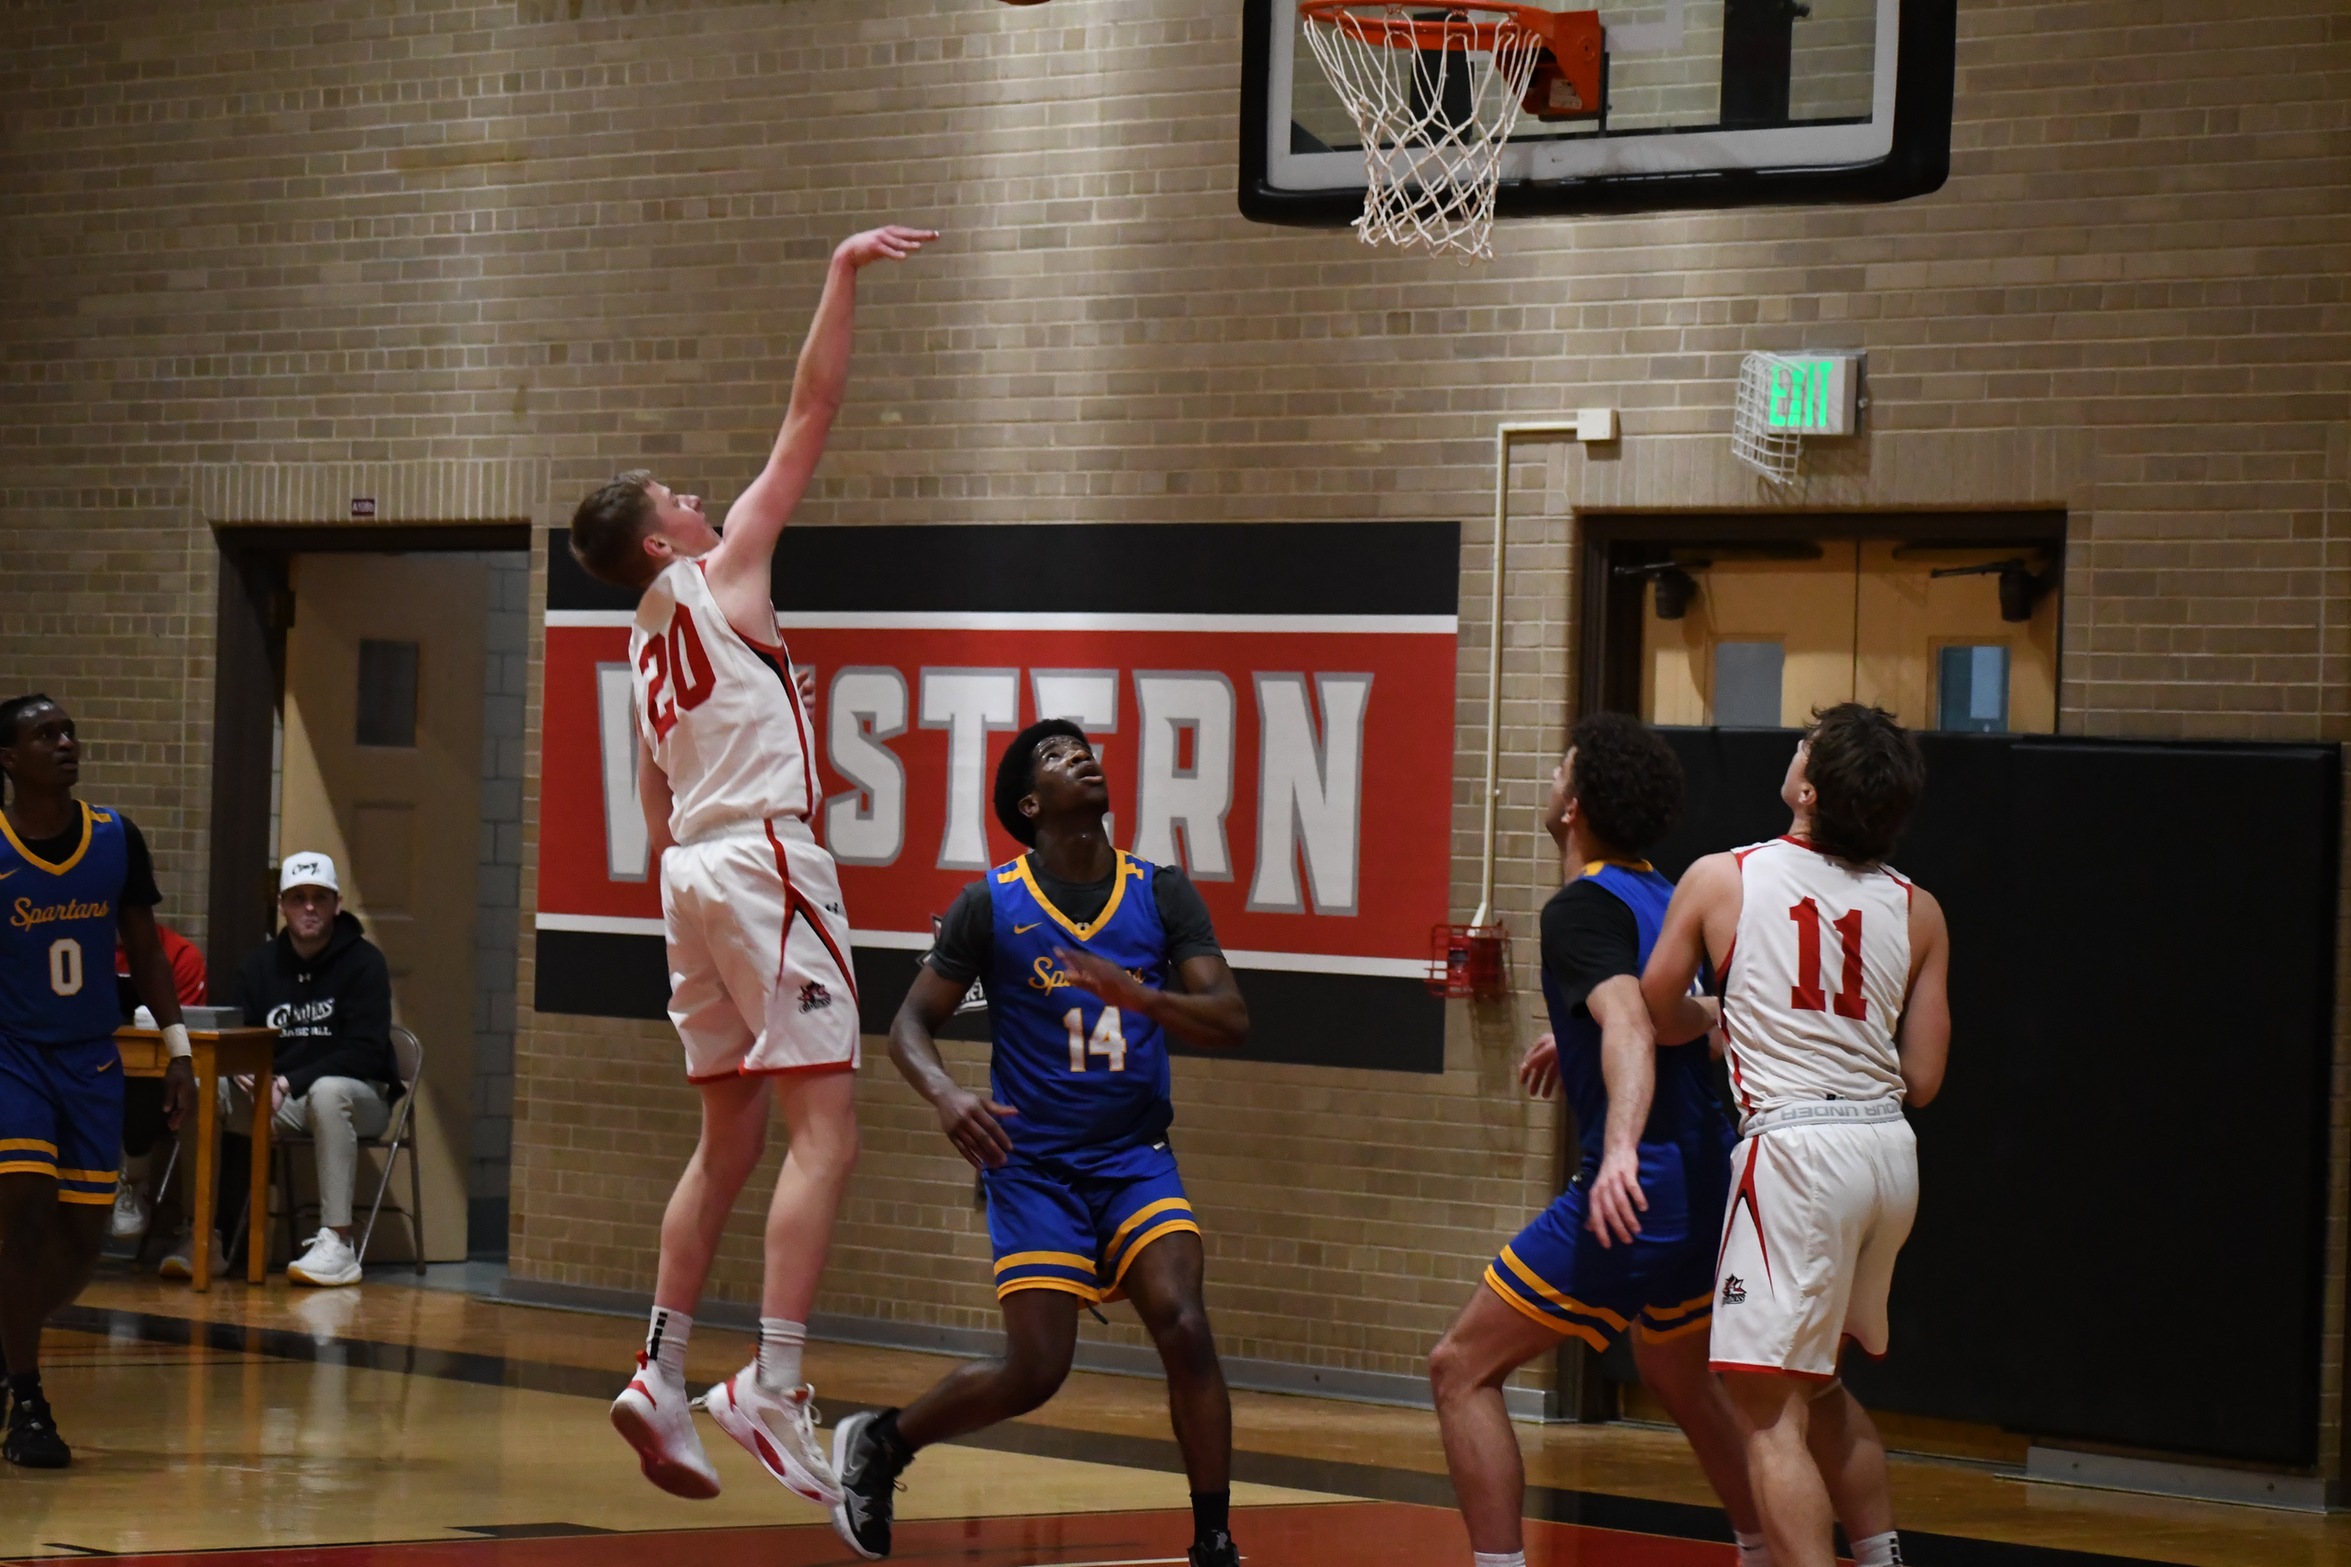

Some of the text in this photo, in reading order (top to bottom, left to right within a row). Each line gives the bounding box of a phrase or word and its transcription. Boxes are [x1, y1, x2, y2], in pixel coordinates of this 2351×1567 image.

[1768, 361, 1833, 427] EXIT
[639, 602, 716, 734] 20
[10, 897, 110, 932] Spartans
[49, 938, 83, 996] 0
[1789, 896, 1867, 1022] 11
[1063, 1006, 1127, 1072] 14
[1780, 1105, 1859, 1121] UNDER
